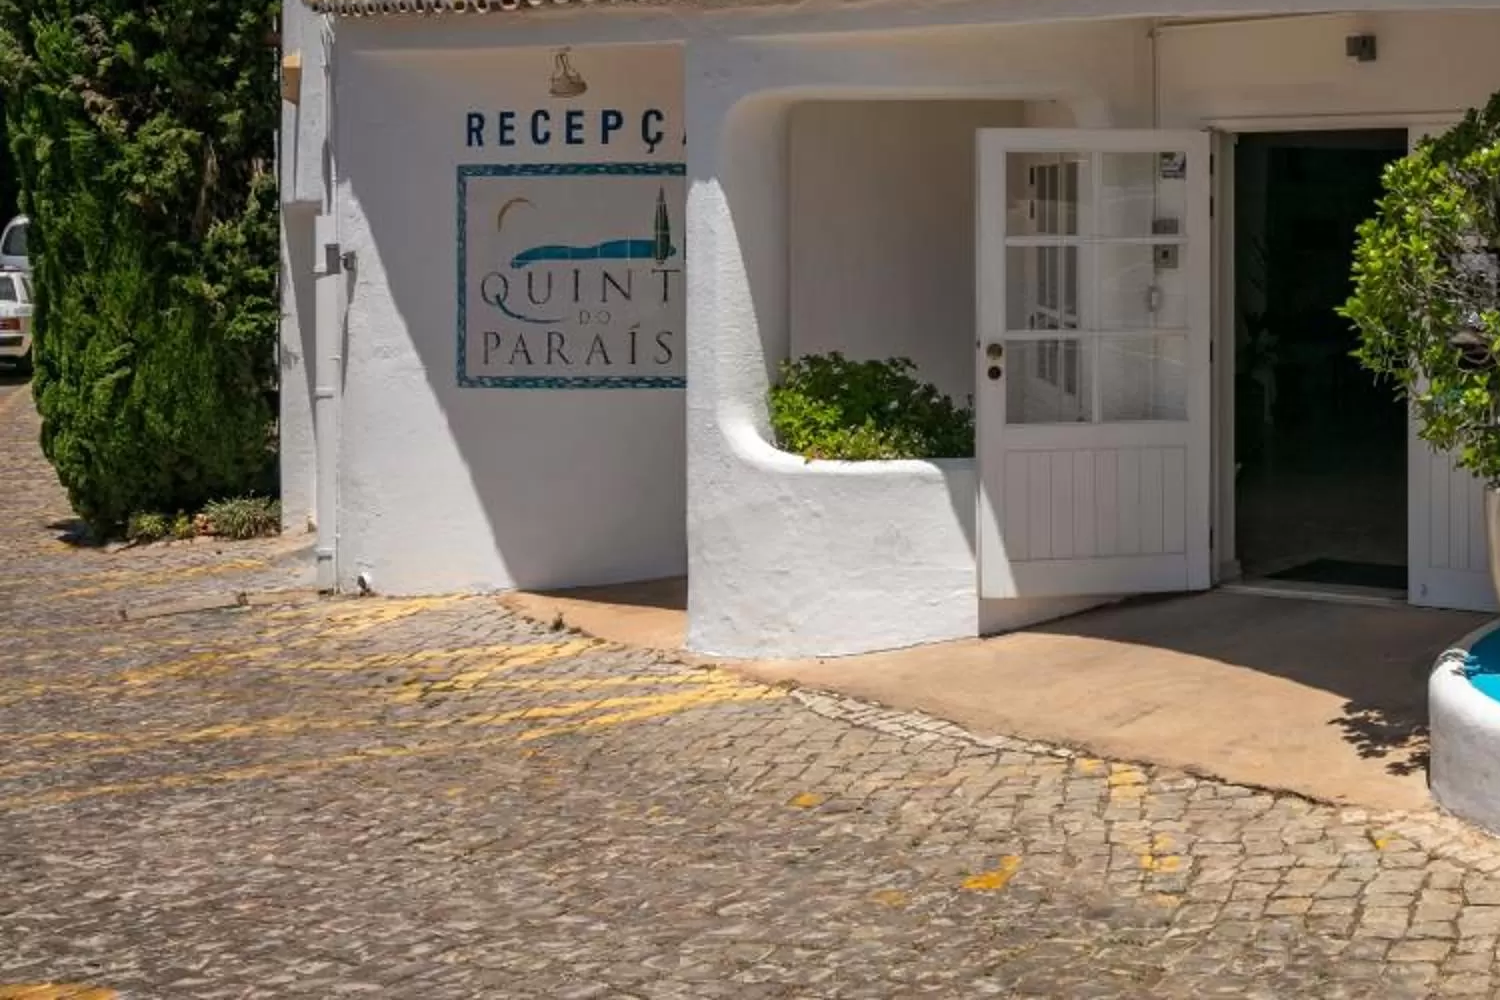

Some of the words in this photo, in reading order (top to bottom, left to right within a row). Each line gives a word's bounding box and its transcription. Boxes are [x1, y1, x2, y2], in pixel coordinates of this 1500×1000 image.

[466, 109, 686, 153] RECEPÇ
[480, 269, 681, 324] QUINT
[579, 310, 611, 325] DO
[482, 323, 674, 366] PARAÍS
